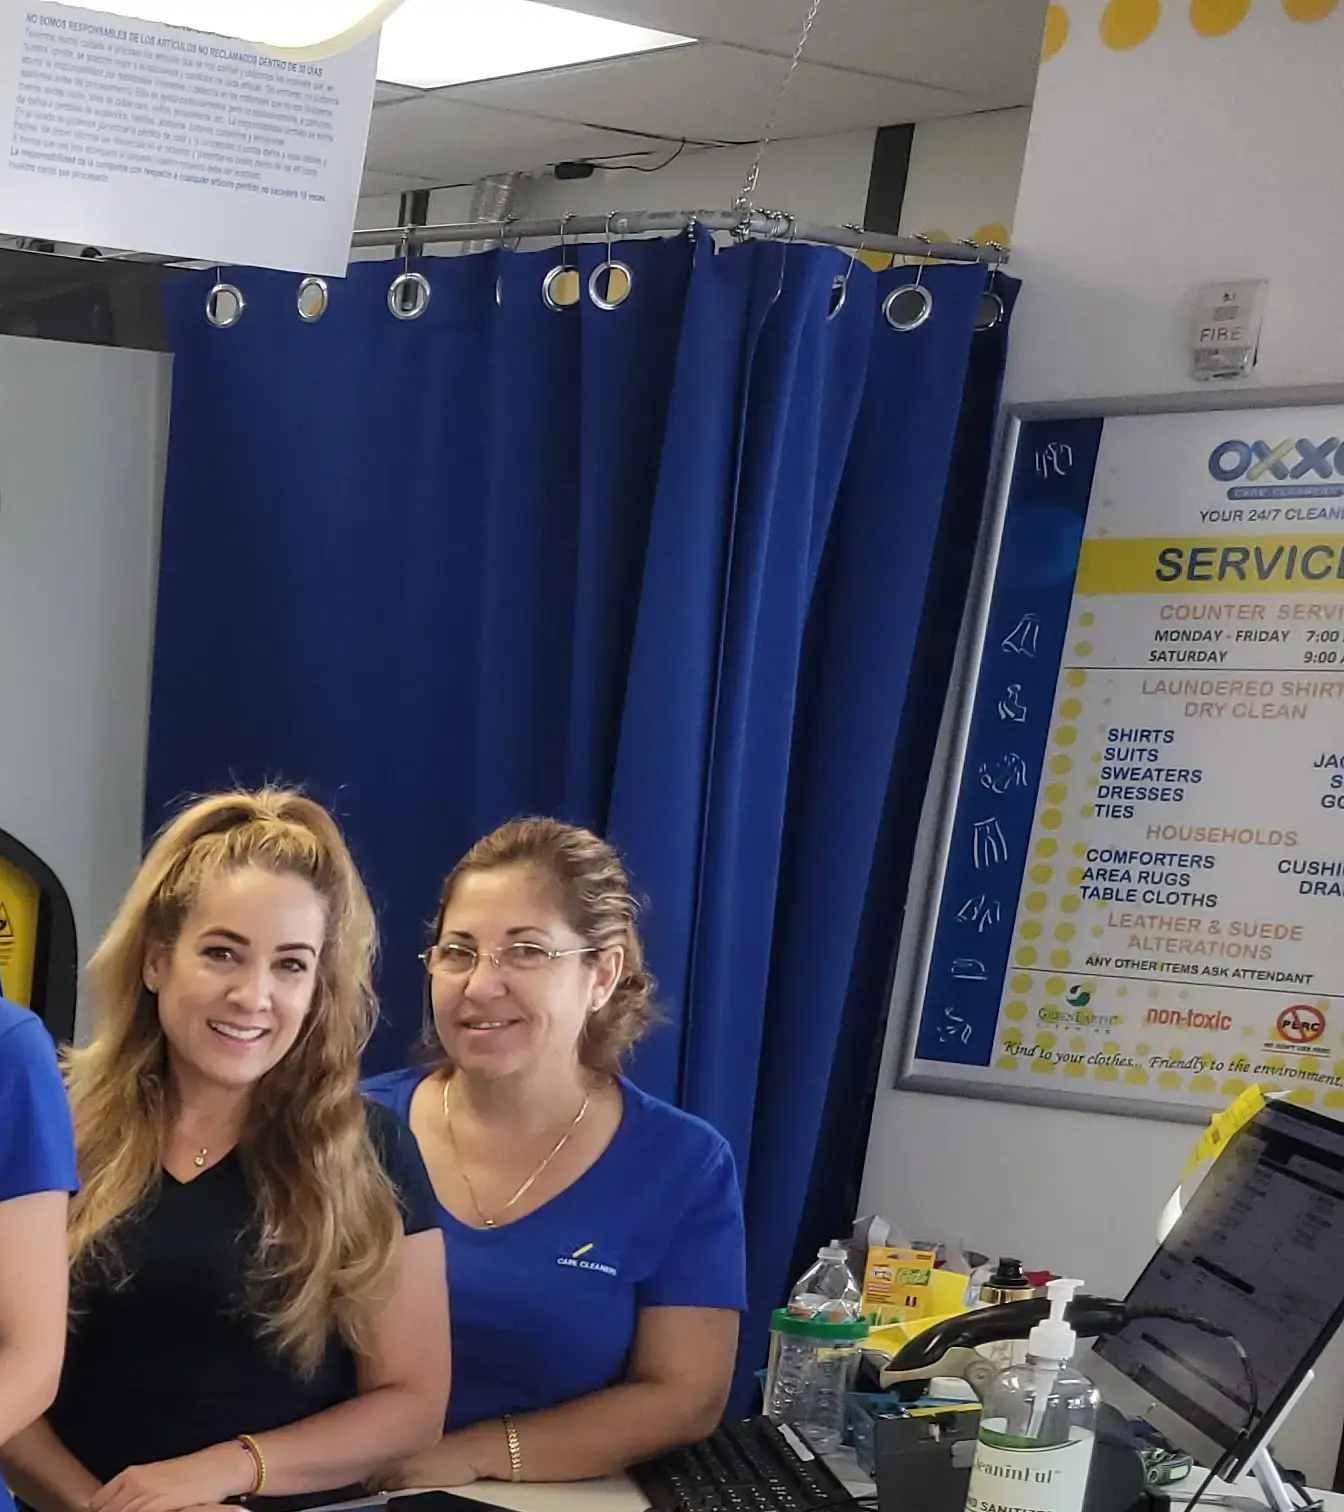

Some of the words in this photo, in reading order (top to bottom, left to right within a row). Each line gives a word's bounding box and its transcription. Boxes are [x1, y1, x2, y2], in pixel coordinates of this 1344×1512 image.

[39, 14, 67, 30] SOMOS
[1199, 325, 1243, 343] FIRE
[1199, 509, 1243, 524] YOUR
[1247, 508, 1281, 522] 24/7
[1159, 604, 1266, 620] COUNTER
[1277, 604, 1344, 621] SERVI
[1154, 629, 1223, 642] MONDAY
[1235, 629, 1291, 643] FRIDAY
[1306, 630, 1340, 643] 7:00
[1148, 650, 1228, 663] SATURDAY
[1303, 651, 1337, 663] 9:00
[1141, 679, 1274, 697] LAUNDERED
[1280, 681, 1344, 698] SHIRT
[1184, 702, 1228, 719] DRY
[1232, 702, 1308, 720] CLEAN
[1107, 728, 1175, 744] SHIRTS
[1103, 747, 1159, 762] SUITS
[1100, 766, 1203, 784] SWEATERS
[1097, 785, 1185, 802] DRESSES
[1093, 804, 1135, 819] TIES
[1145, 824, 1299, 847] HOUSEHOLDS
[1086, 848, 1216, 870] COMFORTERS
[1081, 867, 1132, 884] AREA
[1137, 870, 1191, 887] RUGS
[1079, 885, 1137, 902] TABLE
[1142, 889, 1218, 908] CLOTHS
[1107, 911, 1202, 935] LEATHER
[1208, 919, 1221, 936] &
[1229, 921, 1306, 942] SUEDE
[1127, 934, 1273, 961] ALTERATIONS
[1085, 956, 1112, 968] ANY
[1114, 958, 1157, 972] OTHER
[1159, 963, 1199, 975] ITEMS
[1201, 965, 1230, 977] ASK
[1231, 968, 1314, 985] ATTENDANT
[1146, 1007, 1233, 1031] non-toxic
[1004, 1040, 1039, 1060] Kind
[1039, 1047, 1052, 1060] to
[1052, 1052, 1086, 1068] your
[1149, 1056, 1206, 1075] Friendly
[1210, 1061, 1225, 1072] to
[1228, 1060, 1249, 1073] the
